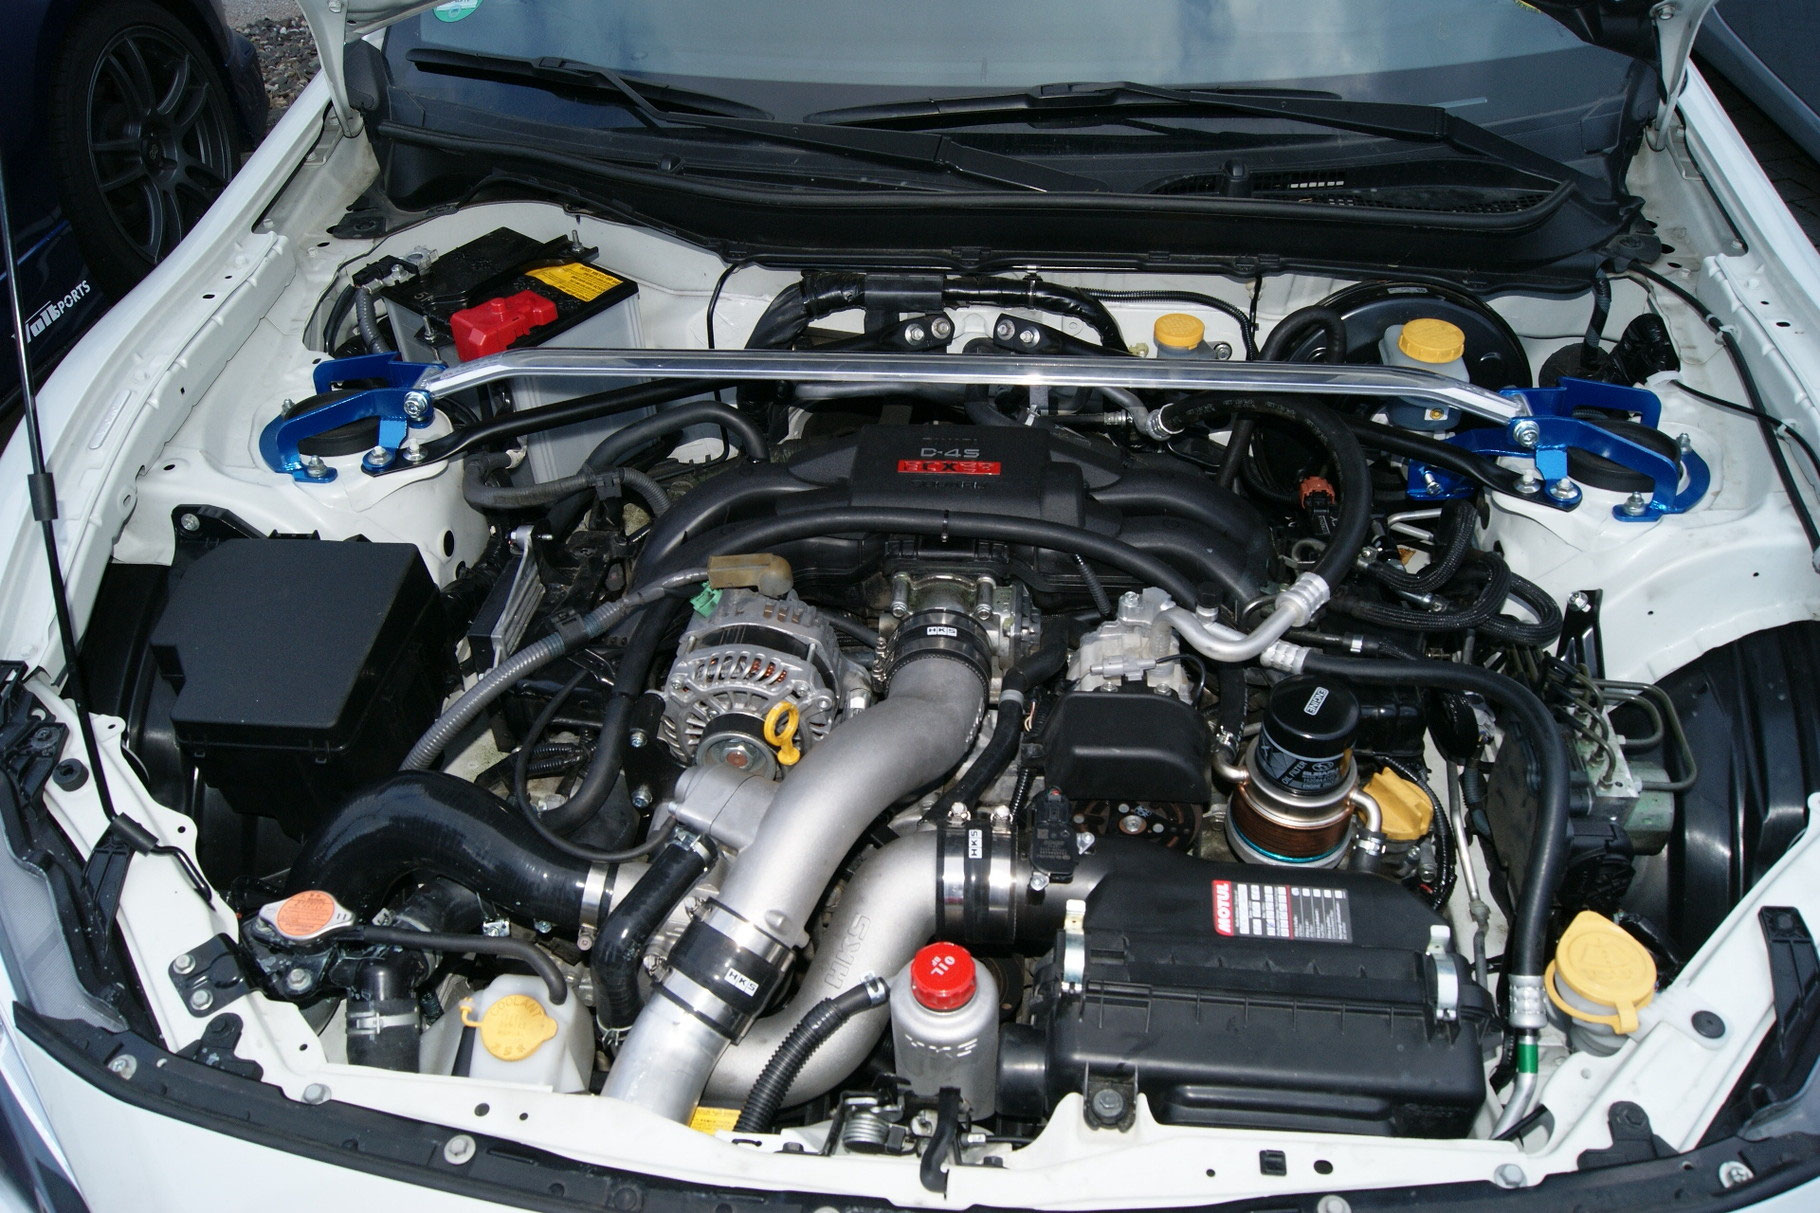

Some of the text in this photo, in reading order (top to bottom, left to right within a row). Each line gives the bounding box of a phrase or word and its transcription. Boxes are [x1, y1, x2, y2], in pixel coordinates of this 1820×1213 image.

[52, 280, 91, 320] SPORTS
[920, 447, 981, 459] D-4S
[928, 627, 956, 636] HKS
[970, 830, 980, 857] HKS
[1215, 882, 1232, 934] MOTUL
[825, 914, 871, 990] HKS
[930, 956, 956, 976] OIL
[727, 970, 758, 993] HKS
